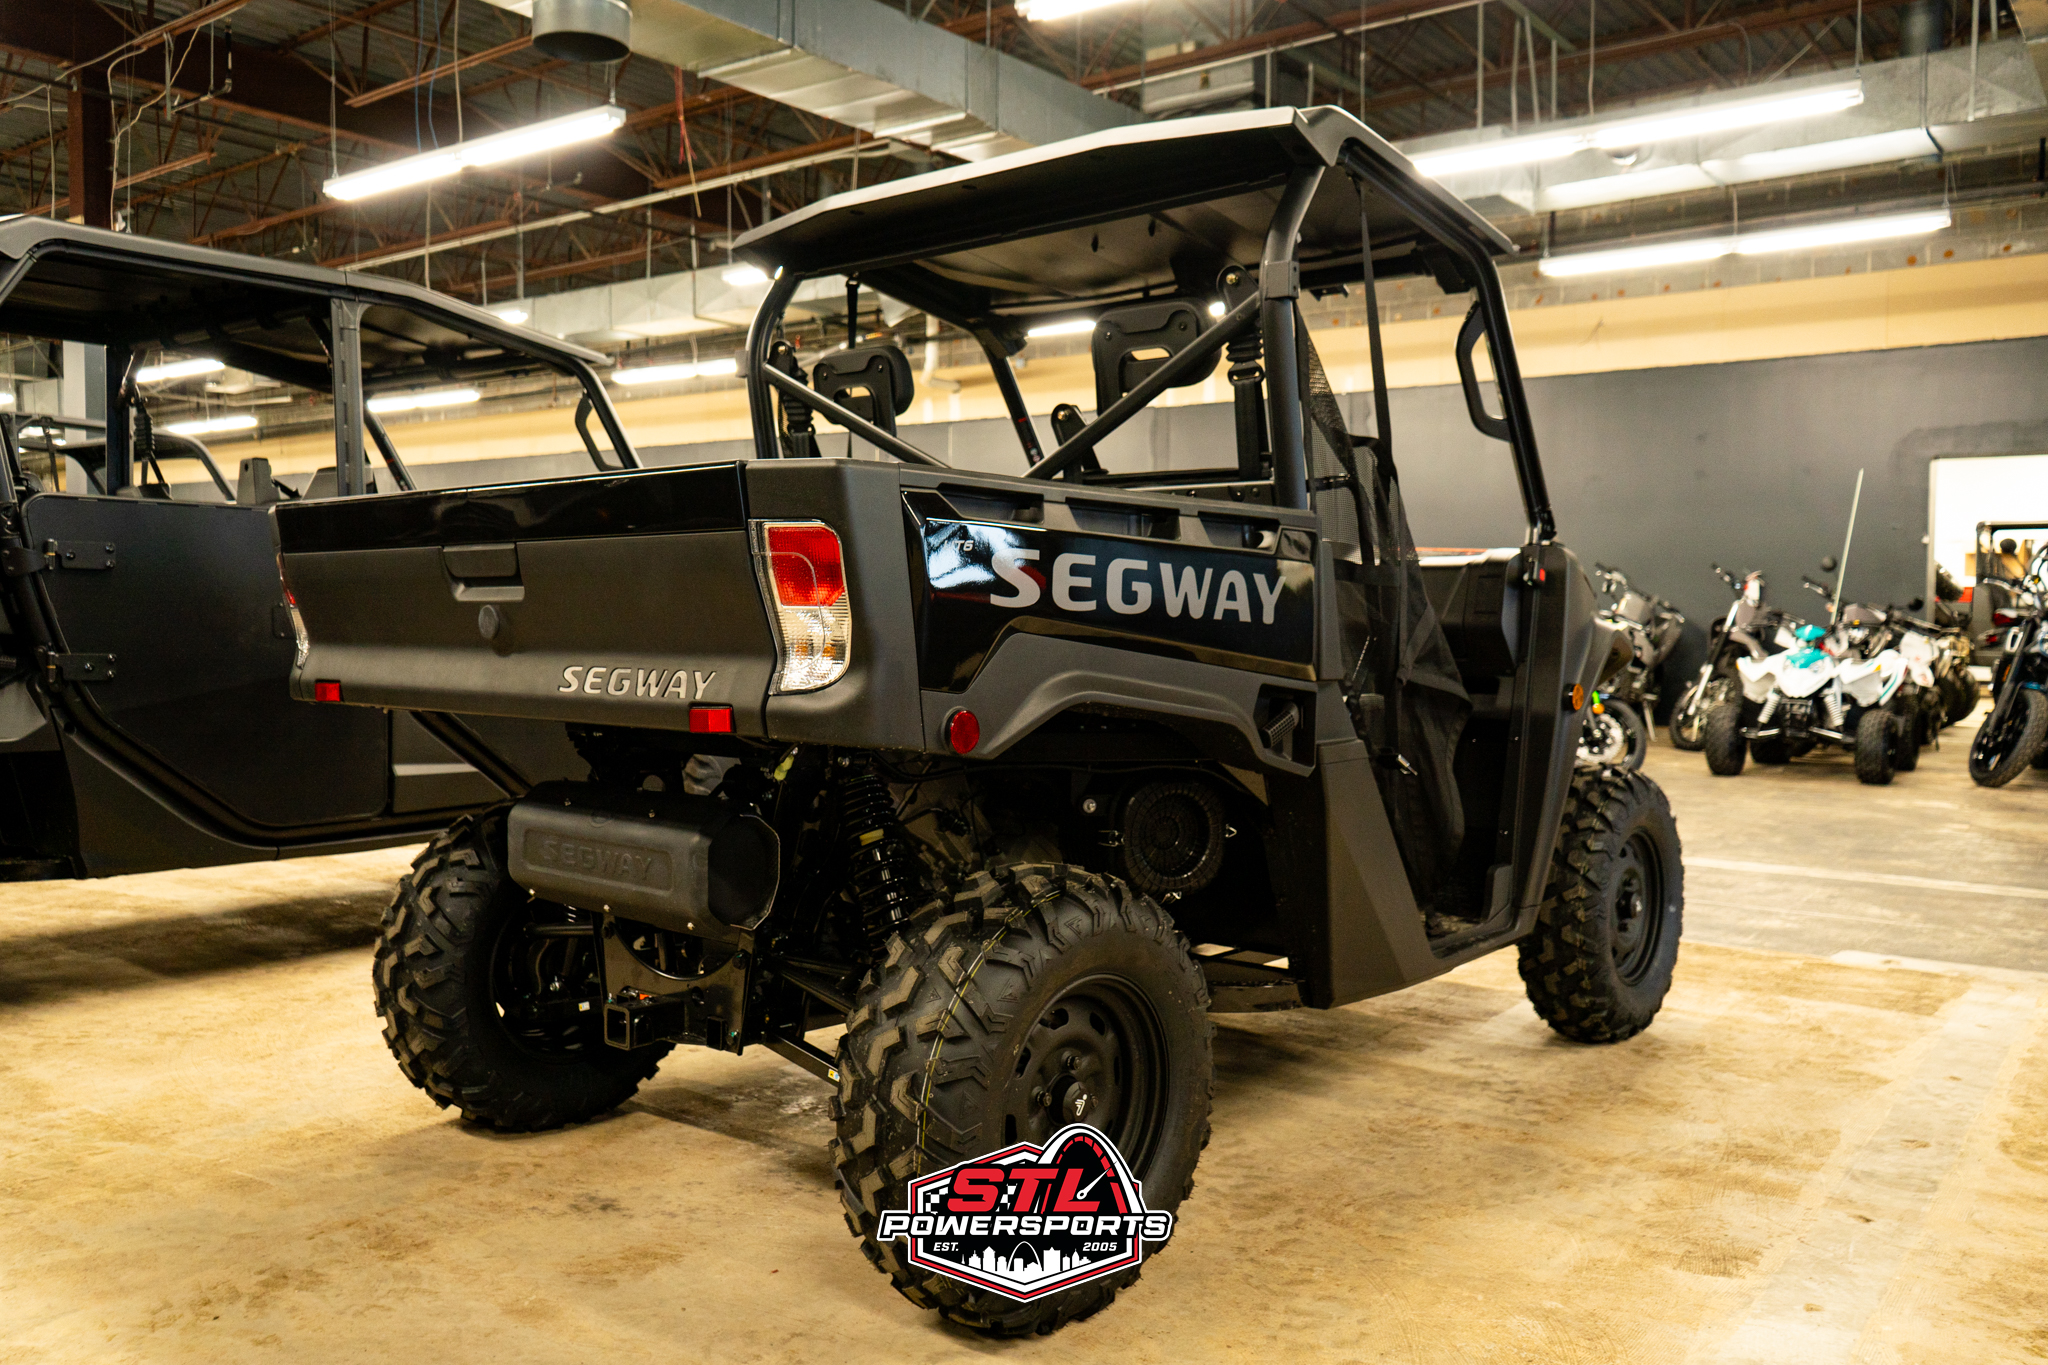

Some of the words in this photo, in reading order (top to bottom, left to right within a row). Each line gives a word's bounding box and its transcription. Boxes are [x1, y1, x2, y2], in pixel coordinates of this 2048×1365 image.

[990, 548, 1286, 625] SEGWAY
[558, 665, 716, 699] SEGWAY
[541, 839, 653, 881] SEGWAY
